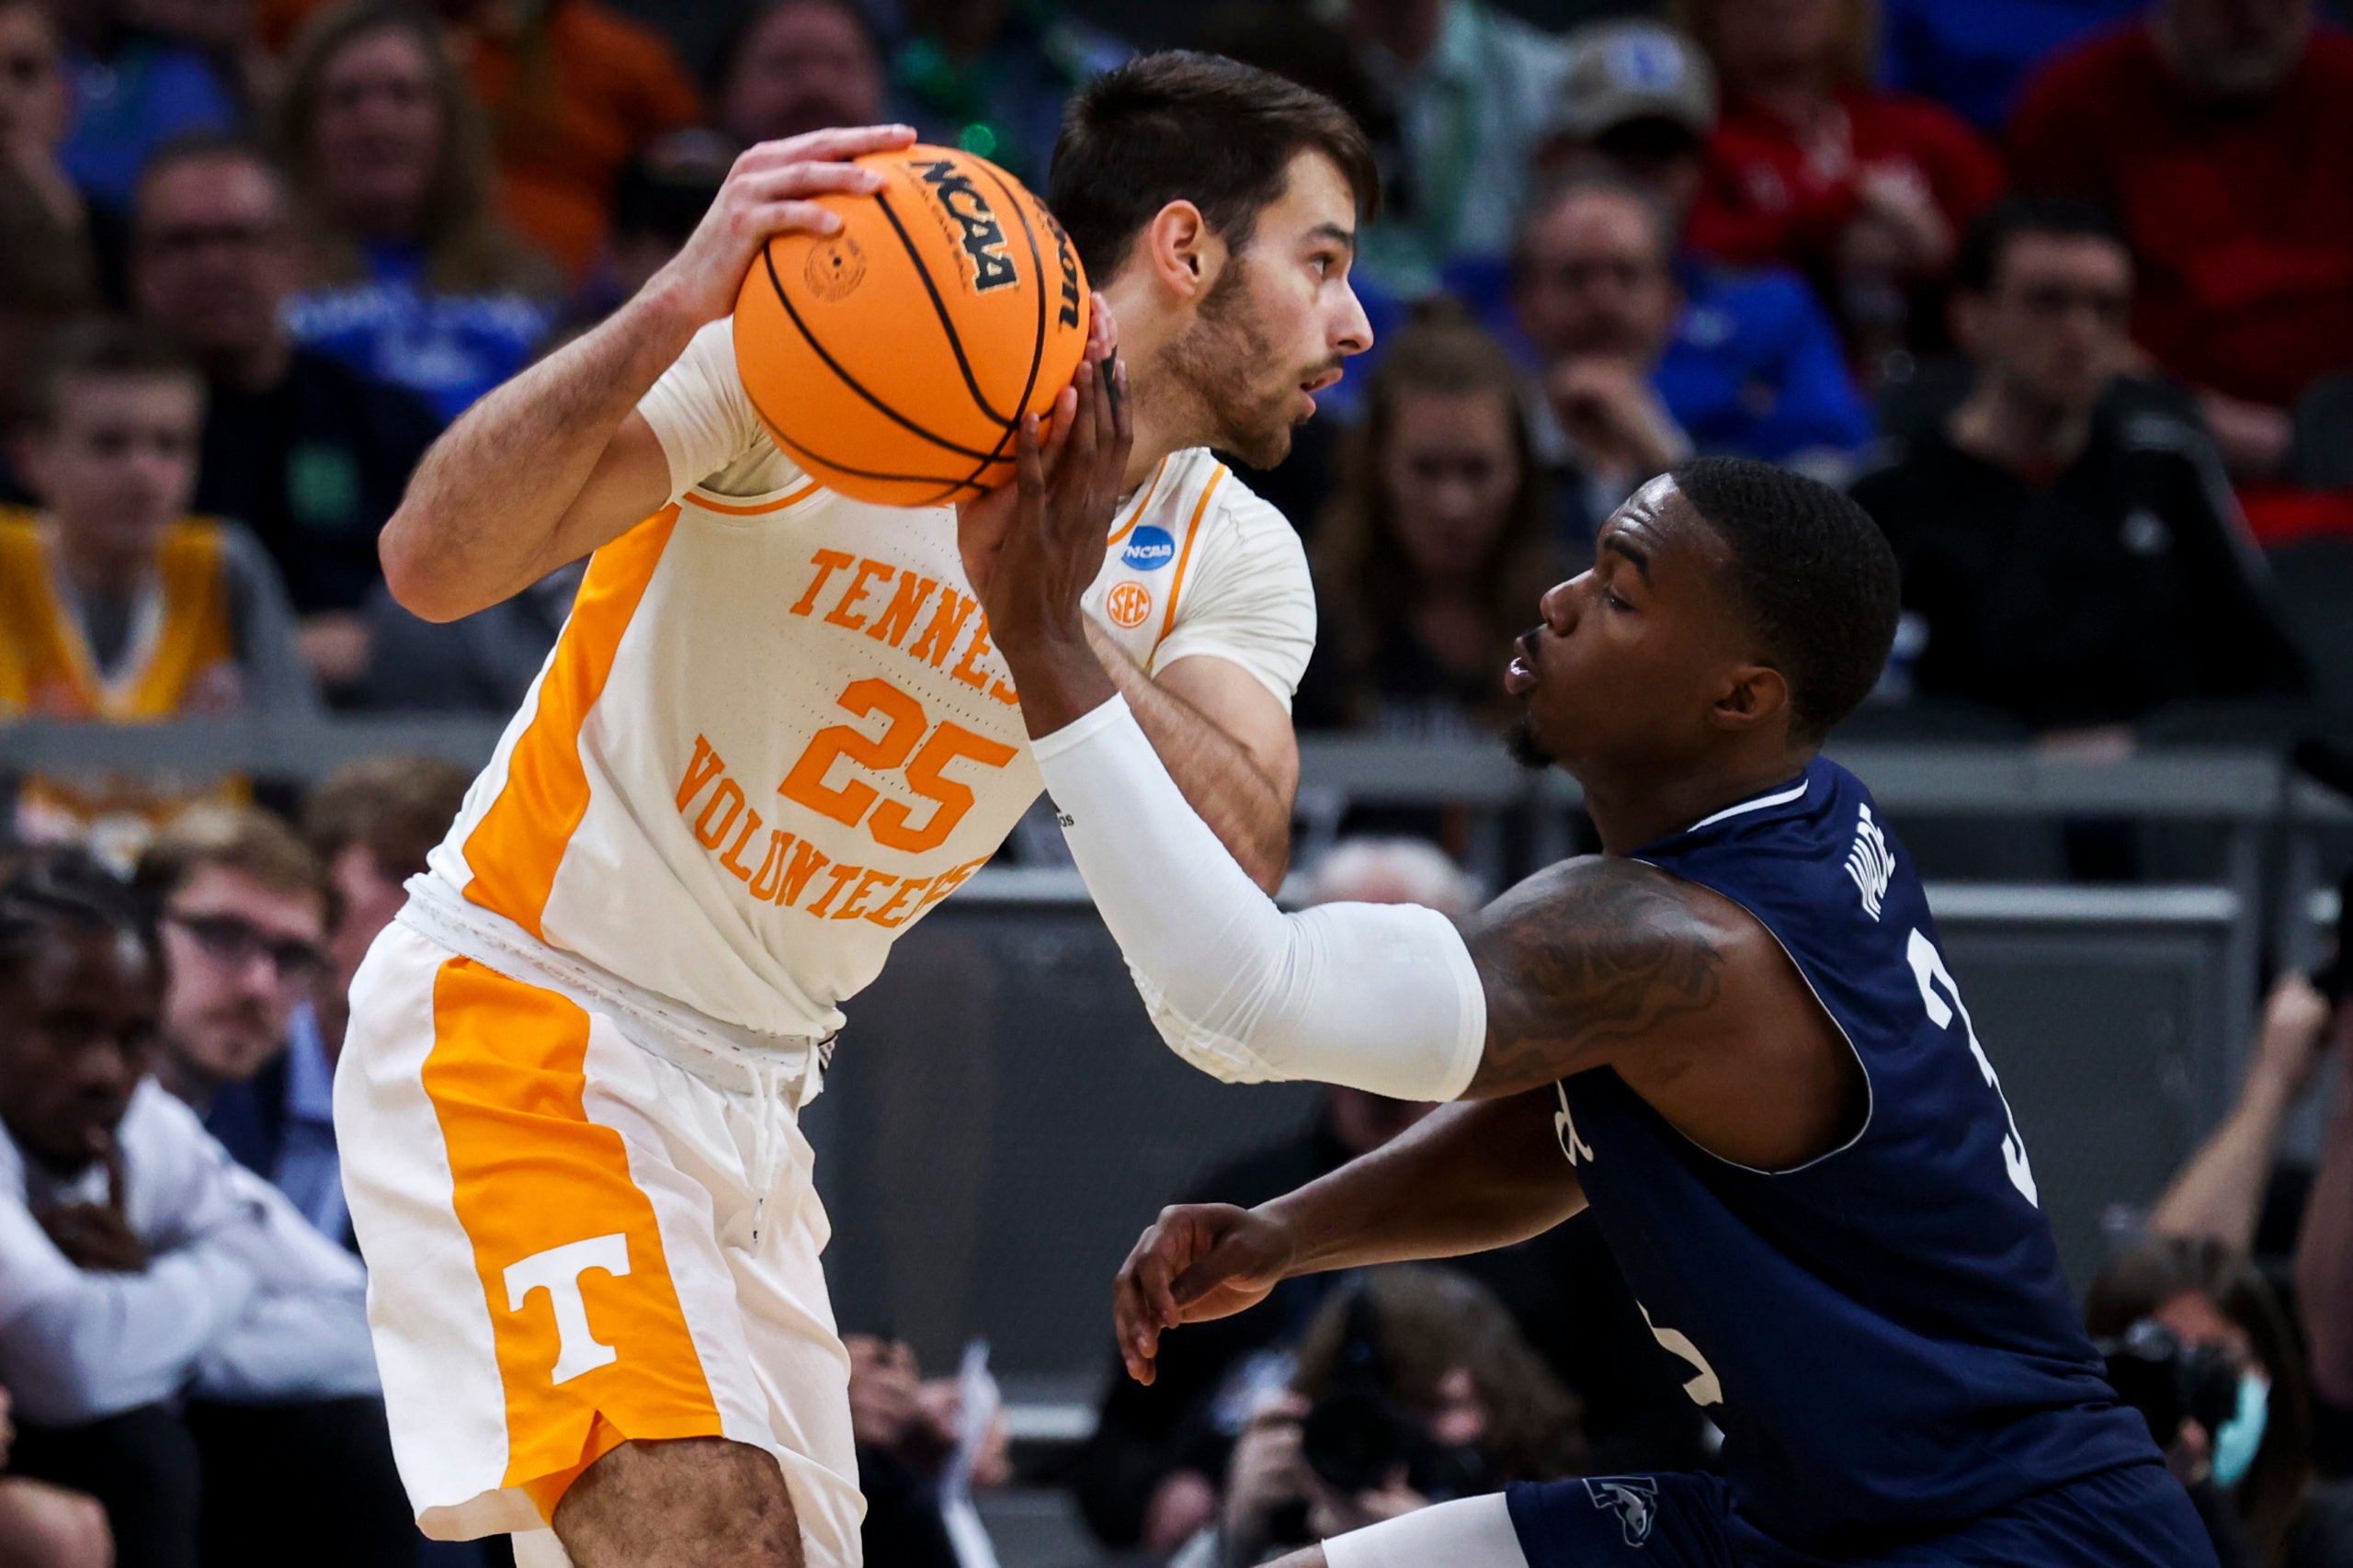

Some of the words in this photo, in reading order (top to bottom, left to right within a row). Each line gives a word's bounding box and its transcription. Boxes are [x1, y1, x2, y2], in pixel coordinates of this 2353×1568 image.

[905, 159, 1019, 296] NCAA
[1112, 585, 1147, 624] SEC
[1126, 543, 1173, 560] NCAA
[777, 677, 1020, 854] 25
[1843, 801, 1896, 923] WADE
[502, 1232, 631, 1386] T
